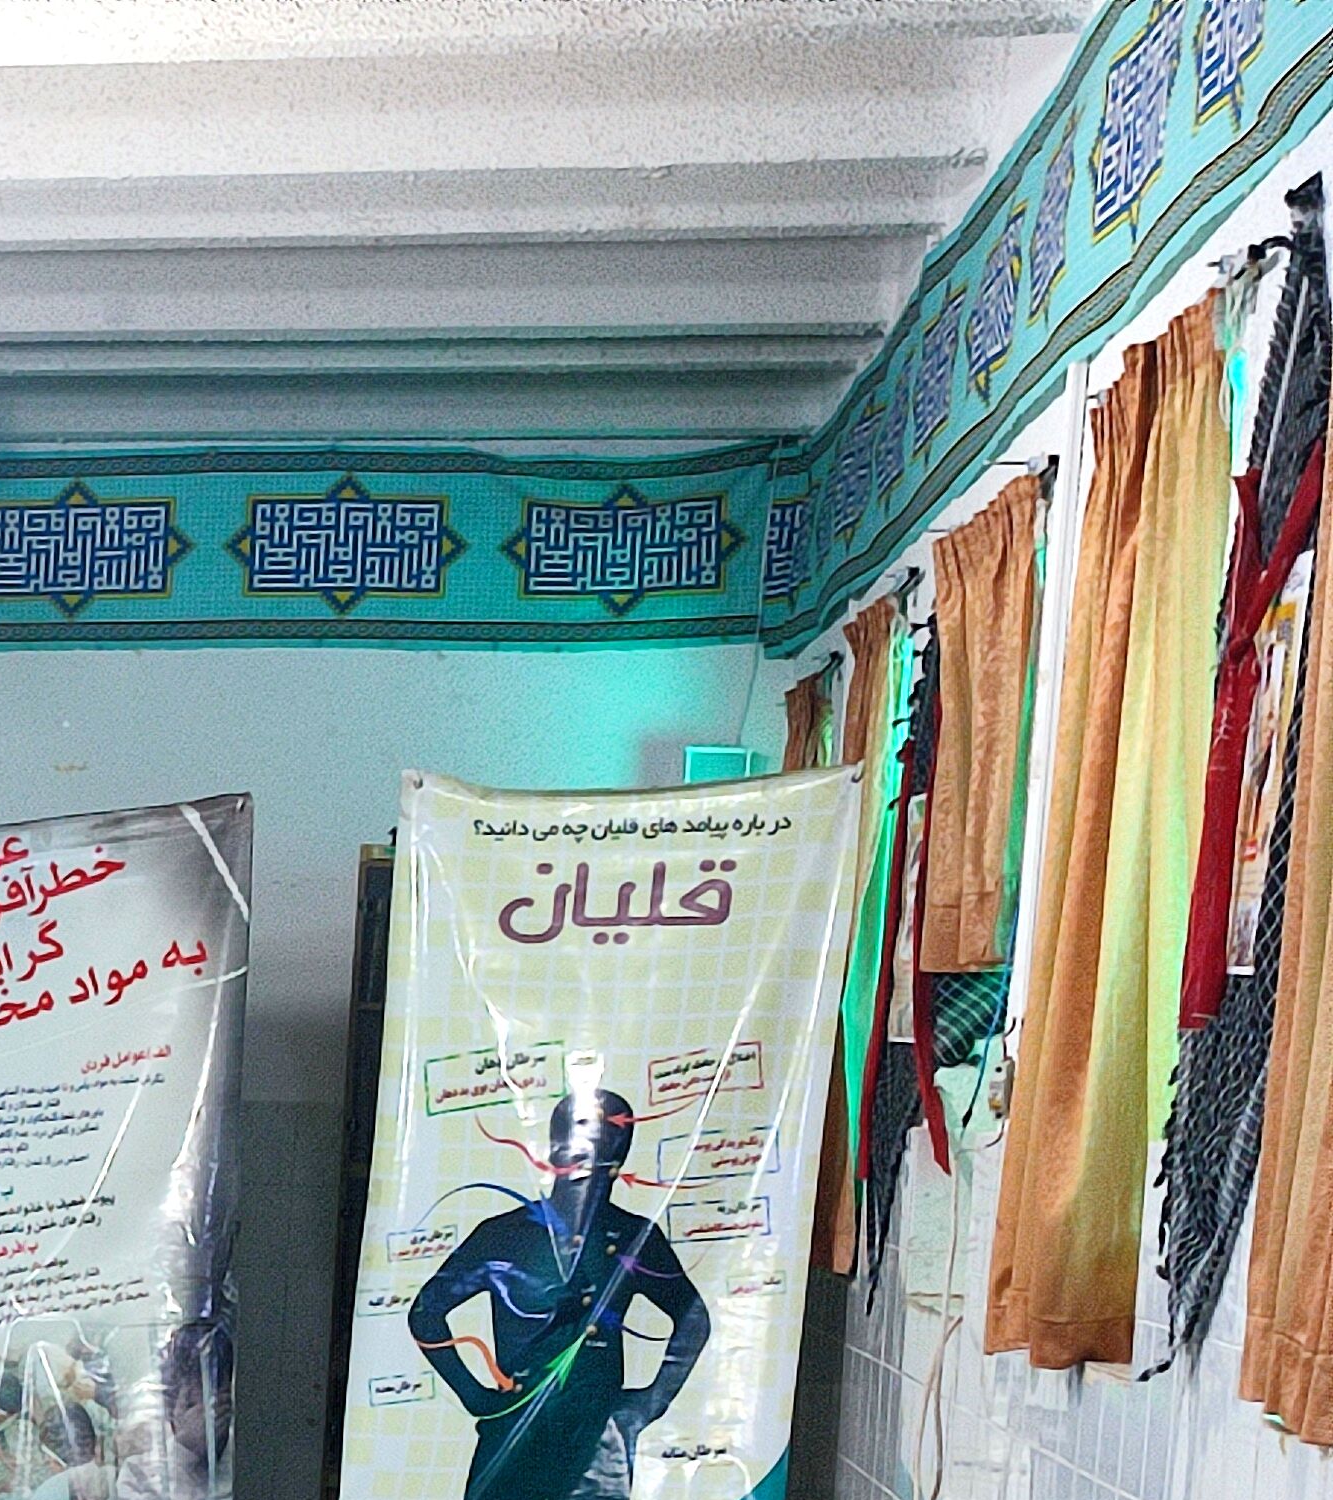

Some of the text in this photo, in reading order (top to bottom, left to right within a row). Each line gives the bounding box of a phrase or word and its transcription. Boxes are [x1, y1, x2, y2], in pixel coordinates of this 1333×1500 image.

[532, 822, 559, 842] می
[561, 822, 589, 843] چه
[590, 817, 640, 841] قلیان
[641, 818, 679, 840] های
[684, 816, 730, 840] پیامد
[731, 814, 766, 837] باره
[768, 816, 793, 837] در
[497, 858, 738, 945] قلیان
[160, 938, 209, 977] به
[67, 955, 151, 1007] مواد
